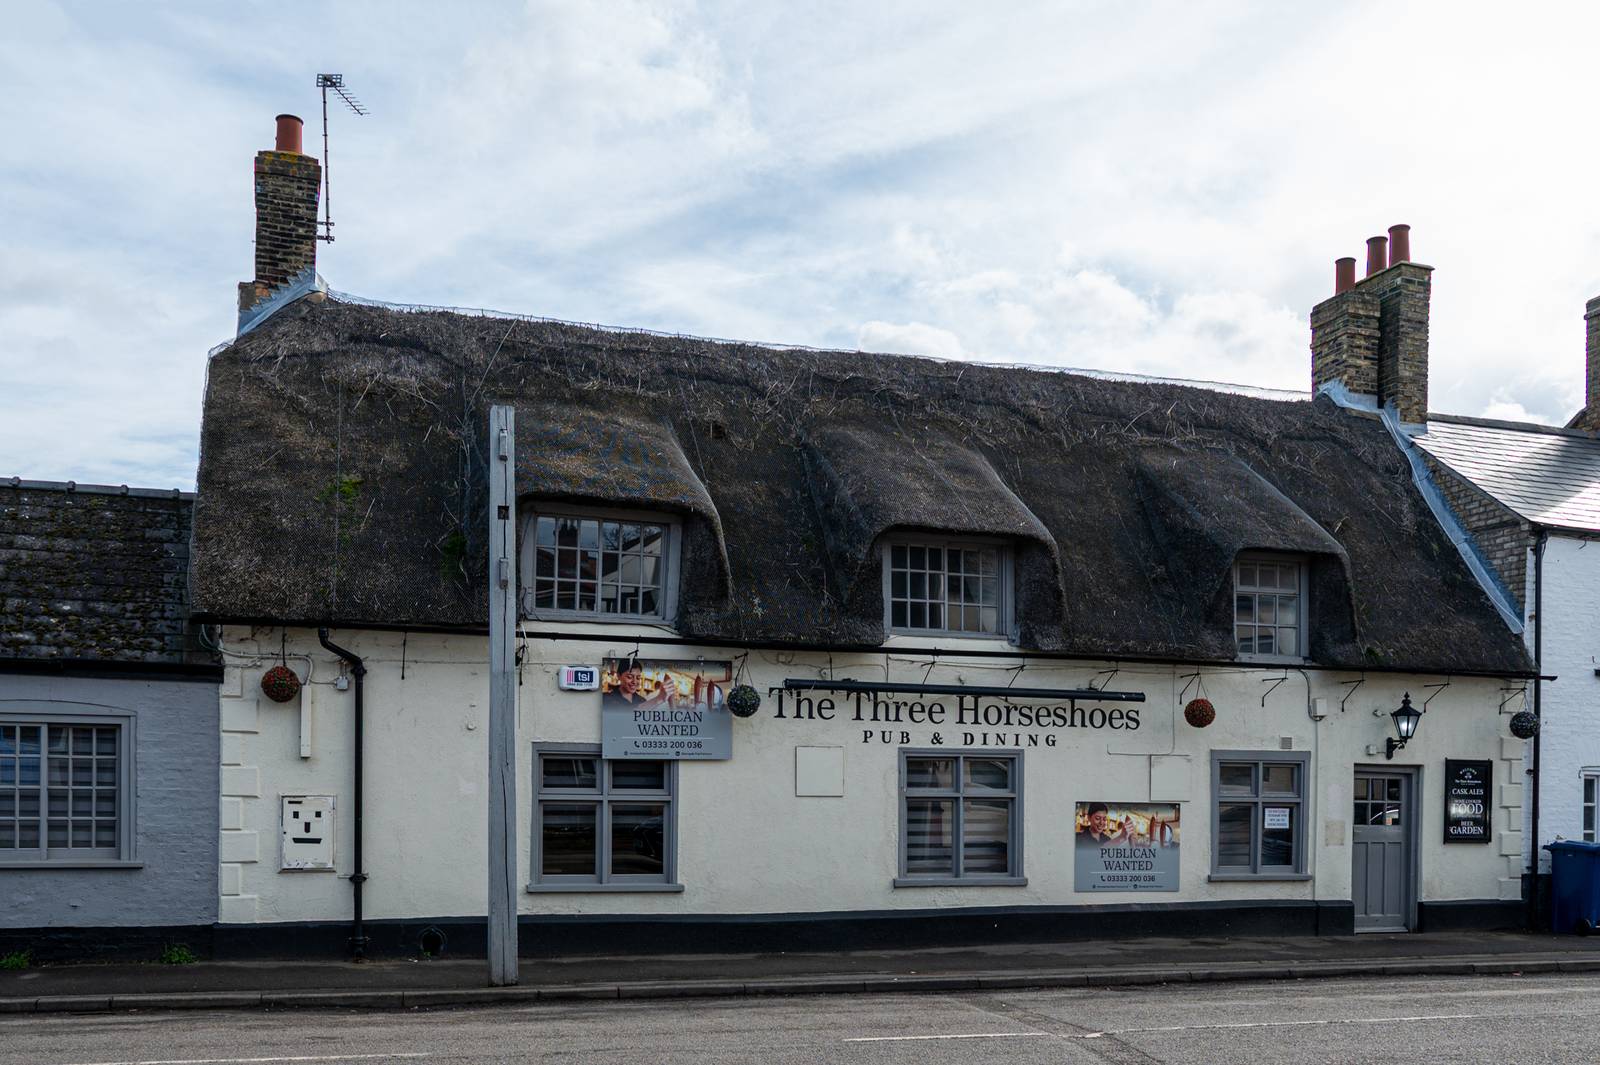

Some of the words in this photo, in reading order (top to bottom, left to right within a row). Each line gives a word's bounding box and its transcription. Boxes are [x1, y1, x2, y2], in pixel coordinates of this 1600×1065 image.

[768, 687, 835, 720] The
[846, 690, 946, 725] Three
[955, 695, 1141, 730] Horseshoes
[633, 710, 703, 723] PUBLICAN
[637, 724, 699, 737] WANTED
[862, 730, 911, 744] PUB
[930, 731, 944, 745] &
[962, 732, 1057, 747] DINING
[642, 741, 668, 749] 03333
[670, 741, 685, 749] 200
[687, 741, 703, 749] 036
[1451, 803, 1484, 814] FOOD
[1450, 826, 1484, 835] GARDEN
[1100, 848, 1157, 859] PUBLICAN
[1103, 860, 1153, 871] WANTED
